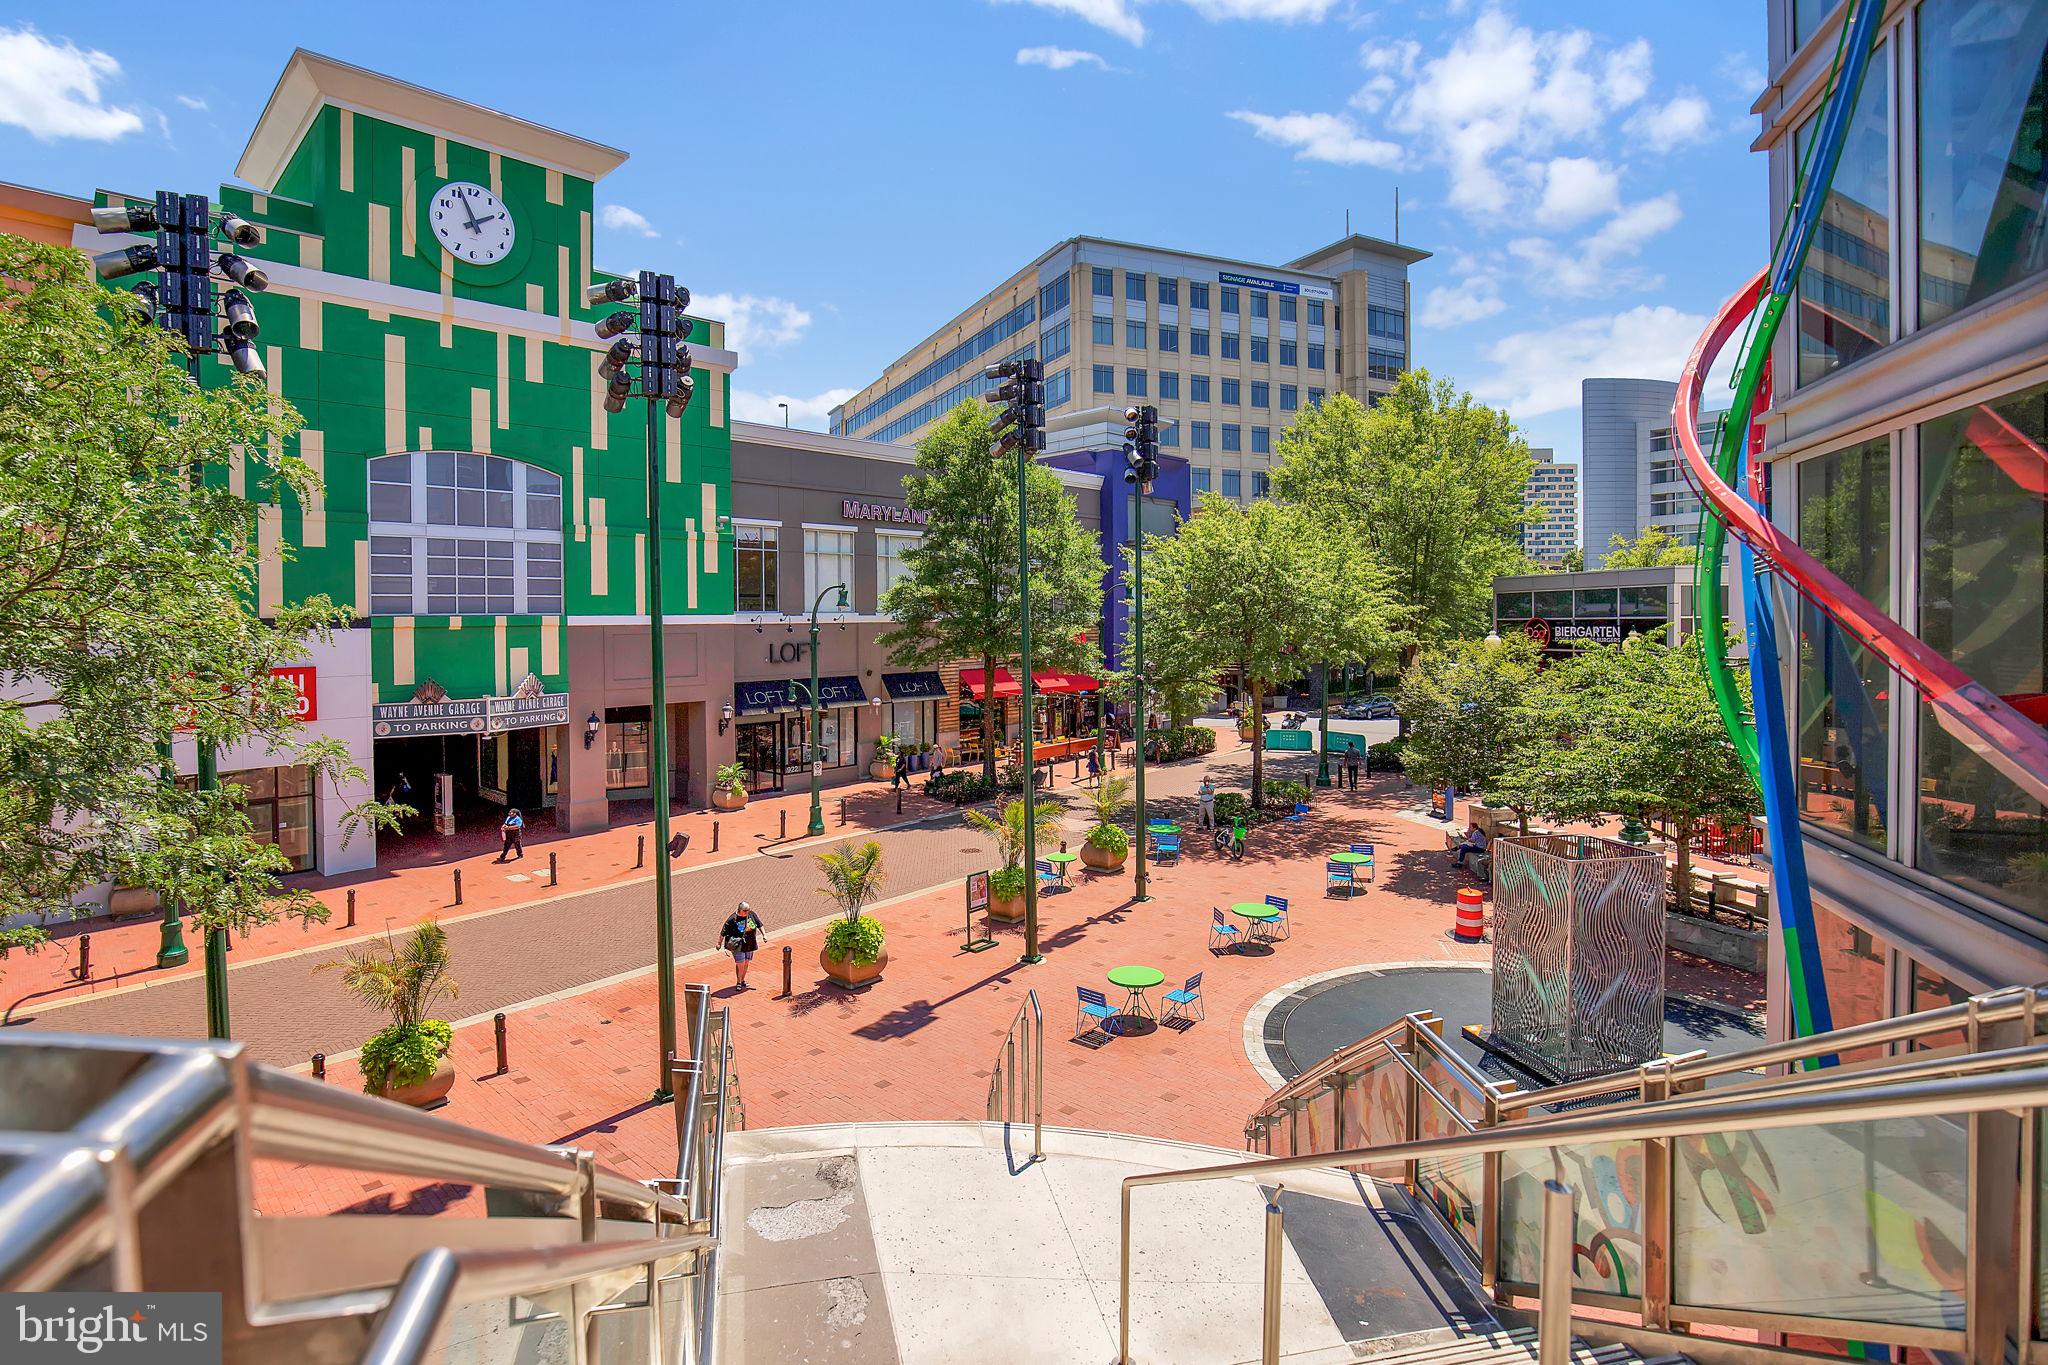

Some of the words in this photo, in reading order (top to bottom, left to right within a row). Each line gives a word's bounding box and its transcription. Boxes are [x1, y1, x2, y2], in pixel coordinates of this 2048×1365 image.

[451, 189, 462, 199] 11
[467, 188, 480, 198] 12
[439, 199, 454, 209] 10
[487, 198, 493, 206] 1
[434, 211, 444, 221] 9
[498, 211, 506, 221] 2
[440, 227, 449, 238] 8
[502, 227, 510, 237] 3
[453, 241, 462, 251] 7
[497, 241, 505, 250] 4
[469, 250, 478, 260] 6
[486, 250, 494, 259] 5
[1222, 274, 1246, 284] SIGNAGE
[1246, 278, 1275, 288] AVAILABLE
[842, 500, 932, 525] MARYLAND
[1554, 626, 1620, 637] BIERGARTEN
[899, 681, 929, 693] LOFT
[745, 690, 783, 705] LOFT
[494, 701, 516, 713] WAYNE
[518, 698, 540, 711] AVENUE
[542, 696, 564, 708] GARAGE
[380, 705, 408, 719] WAYNE
[413, 704, 444, 717] AVENUE
[448, 702, 480, 715] GARAGE
[505, 717, 517, 725] TO
[519, 713, 556, 724] PARKING
[394, 723, 411, 732] TO
[415, 720, 468, 731] PARKING
[786, 765, 799, 773] 922
